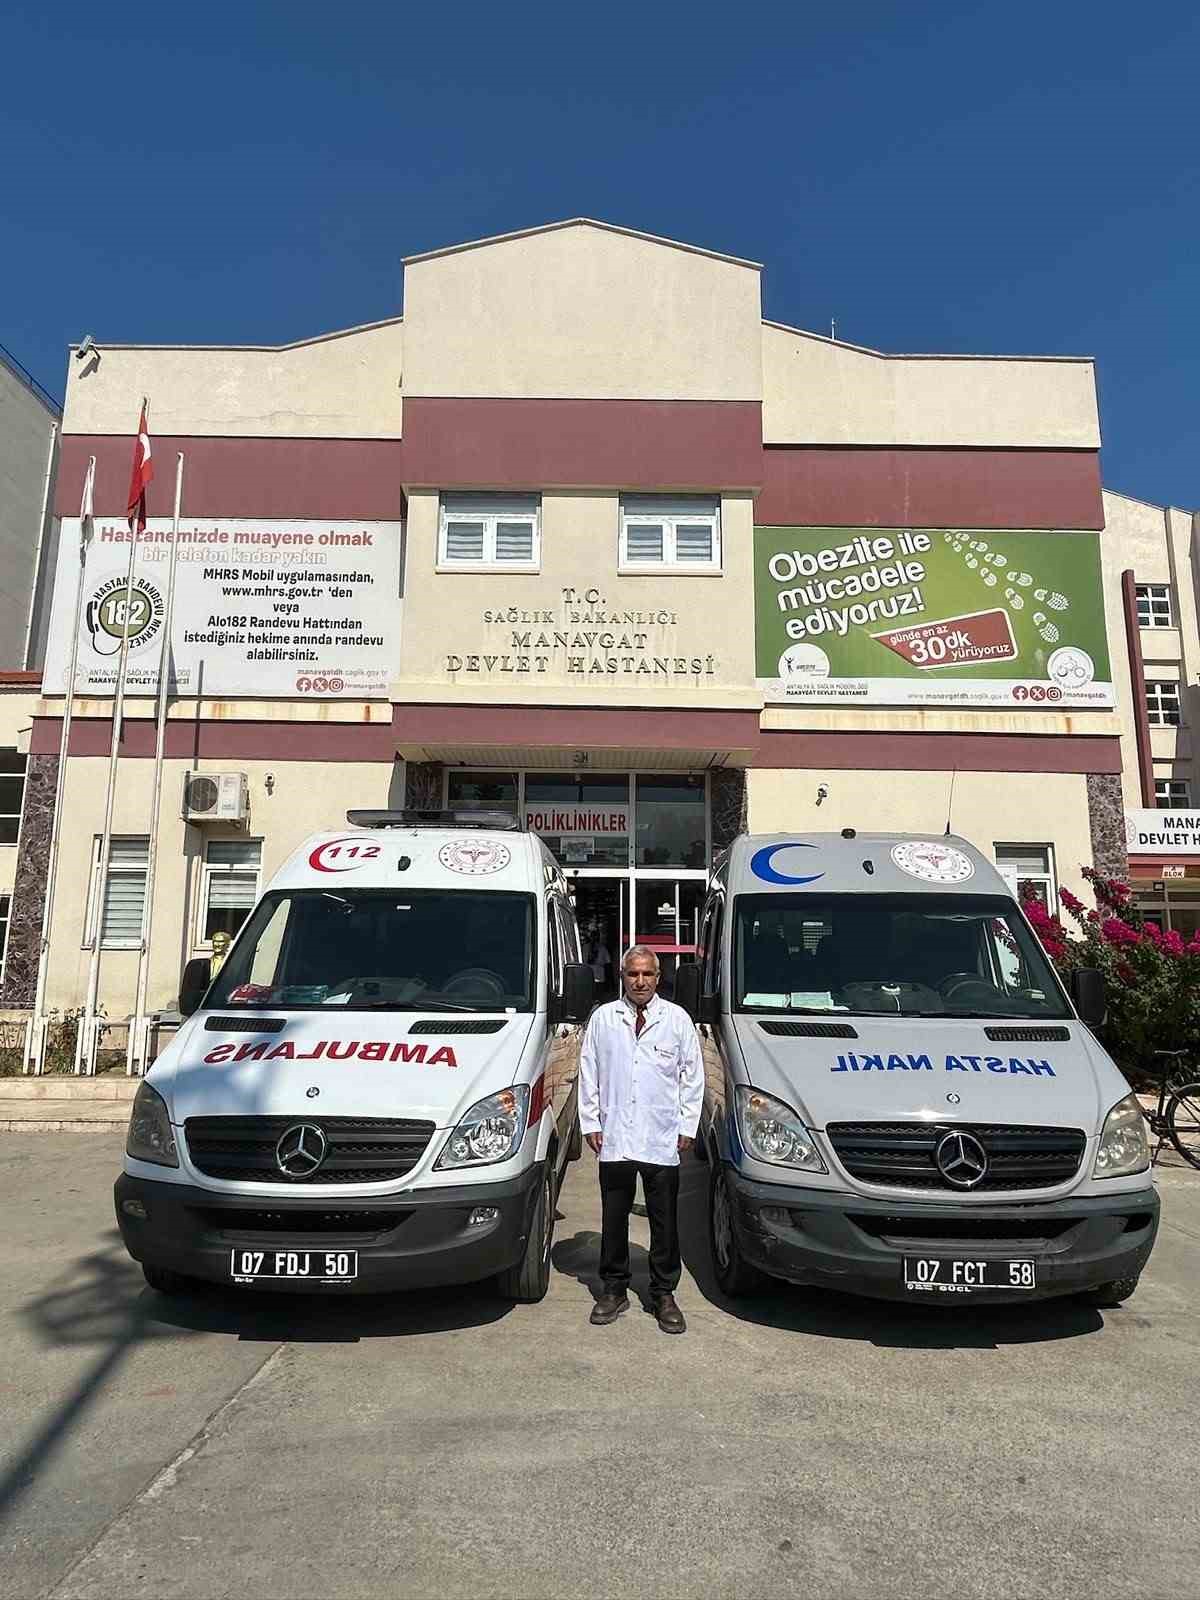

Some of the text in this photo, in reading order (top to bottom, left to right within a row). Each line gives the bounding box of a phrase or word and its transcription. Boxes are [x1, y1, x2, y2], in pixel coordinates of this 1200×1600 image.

[233, 532, 314, 548] muayene
[318, 530, 373, 545] olmak
[143, 546, 168, 561] bir
[231, 547, 279, 564] kadar
[768, 532, 931, 582] Obezite ile
[203, 568, 374, 584] MHRS Mobil uygulamasından,
[222, 585, 323, 599] www.mhrs.gov.tr
[777, 560, 925, 612] mücadele
[137, 578, 164, 616] RANDEVU
[562, 588, 607, 604] T.C.
[105, 599, 146, 625] 182
[273, 603, 299, 615] veya
[483, 607, 678, 625] SAĞLIK BAKANLIĞI
[786, 587, 925, 639] ediyoruz!
[207, 616, 362, 629] Alo182 Randevu Hattından
[184, 630, 384, 646] istediğiniz hekime anında randevu
[511, 631, 647, 649] MANAVGAT
[889, 624, 949, 646] günde en az
[247, 648, 319, 661] alabilirsiniz.
[909, 630, 973, 663] 30 dk
[951, 643, 1010, 660] yürüyoruz
[446, 655, 715, 674] DEVLET HASTANESİ
[526, 809, 626, 831] POLİKLİNİKLER
[1138, 833, 1189, 845] DEVLET
[328, 846, 381, 858] 112
[242, 1252, 349, 1275] 07 FDJ 50
[917, 1260, 1032, 1285] 07 FCT 58
